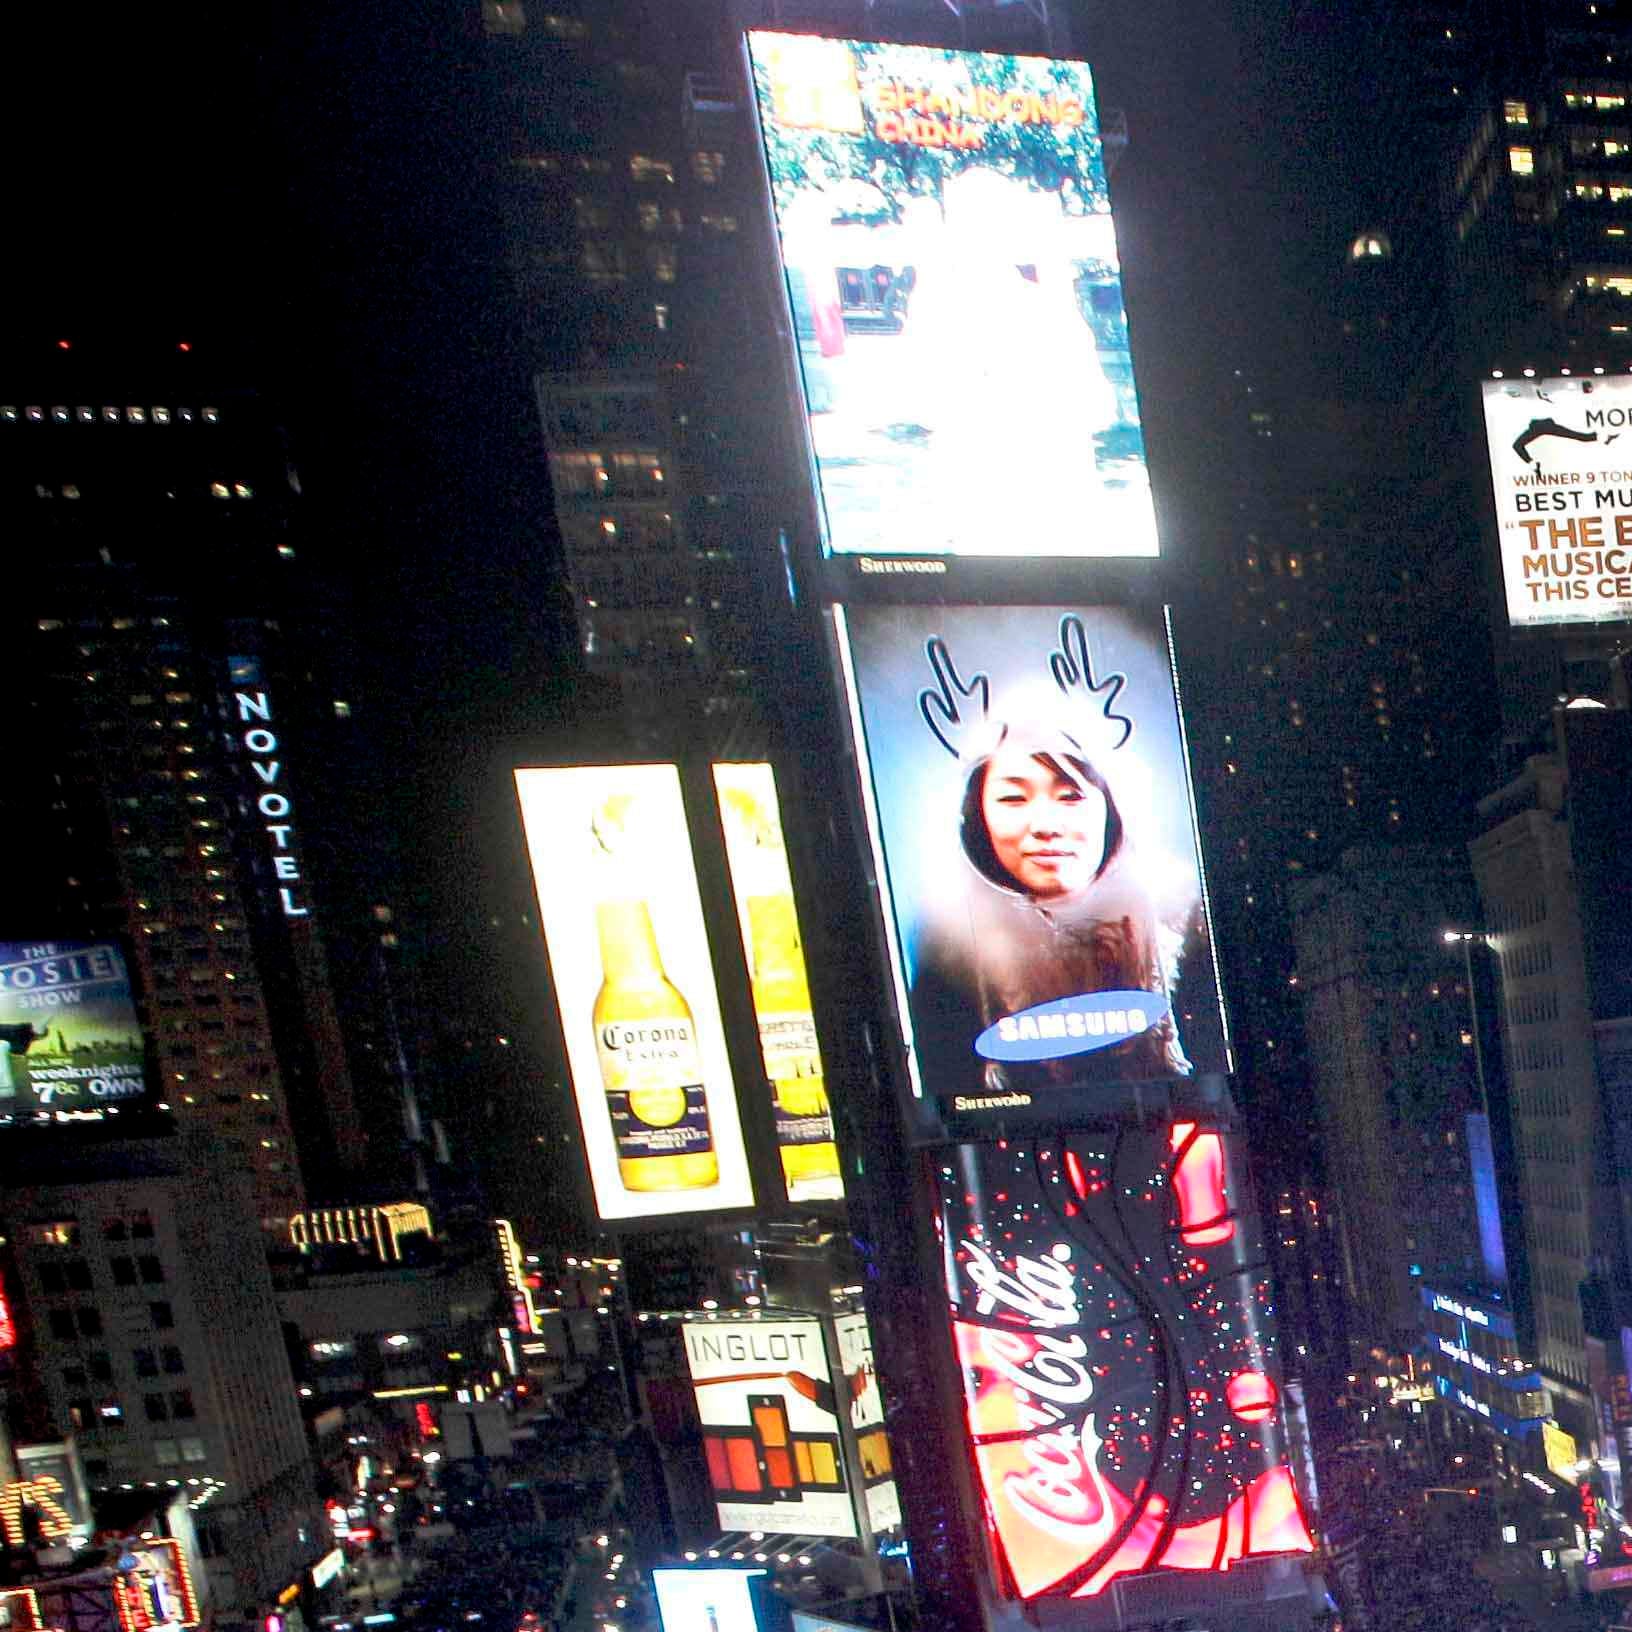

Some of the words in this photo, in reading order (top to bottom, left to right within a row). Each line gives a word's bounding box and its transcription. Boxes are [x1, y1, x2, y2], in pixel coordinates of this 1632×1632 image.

[1512, 471, 1581, 487] WINNER
[1586, 472, 1596, 485] 9
[1515, 491, 1583, 513] BEST
[1526, 578, 1590, 602] THIS
[235, 690, 309, 919] NOVOTEL
[602, 1024, 689, 1051] Corona
[998, 1008, 1147, 1042] SAMSUNG
[690, 1333, 808, 1362] INGLOT
